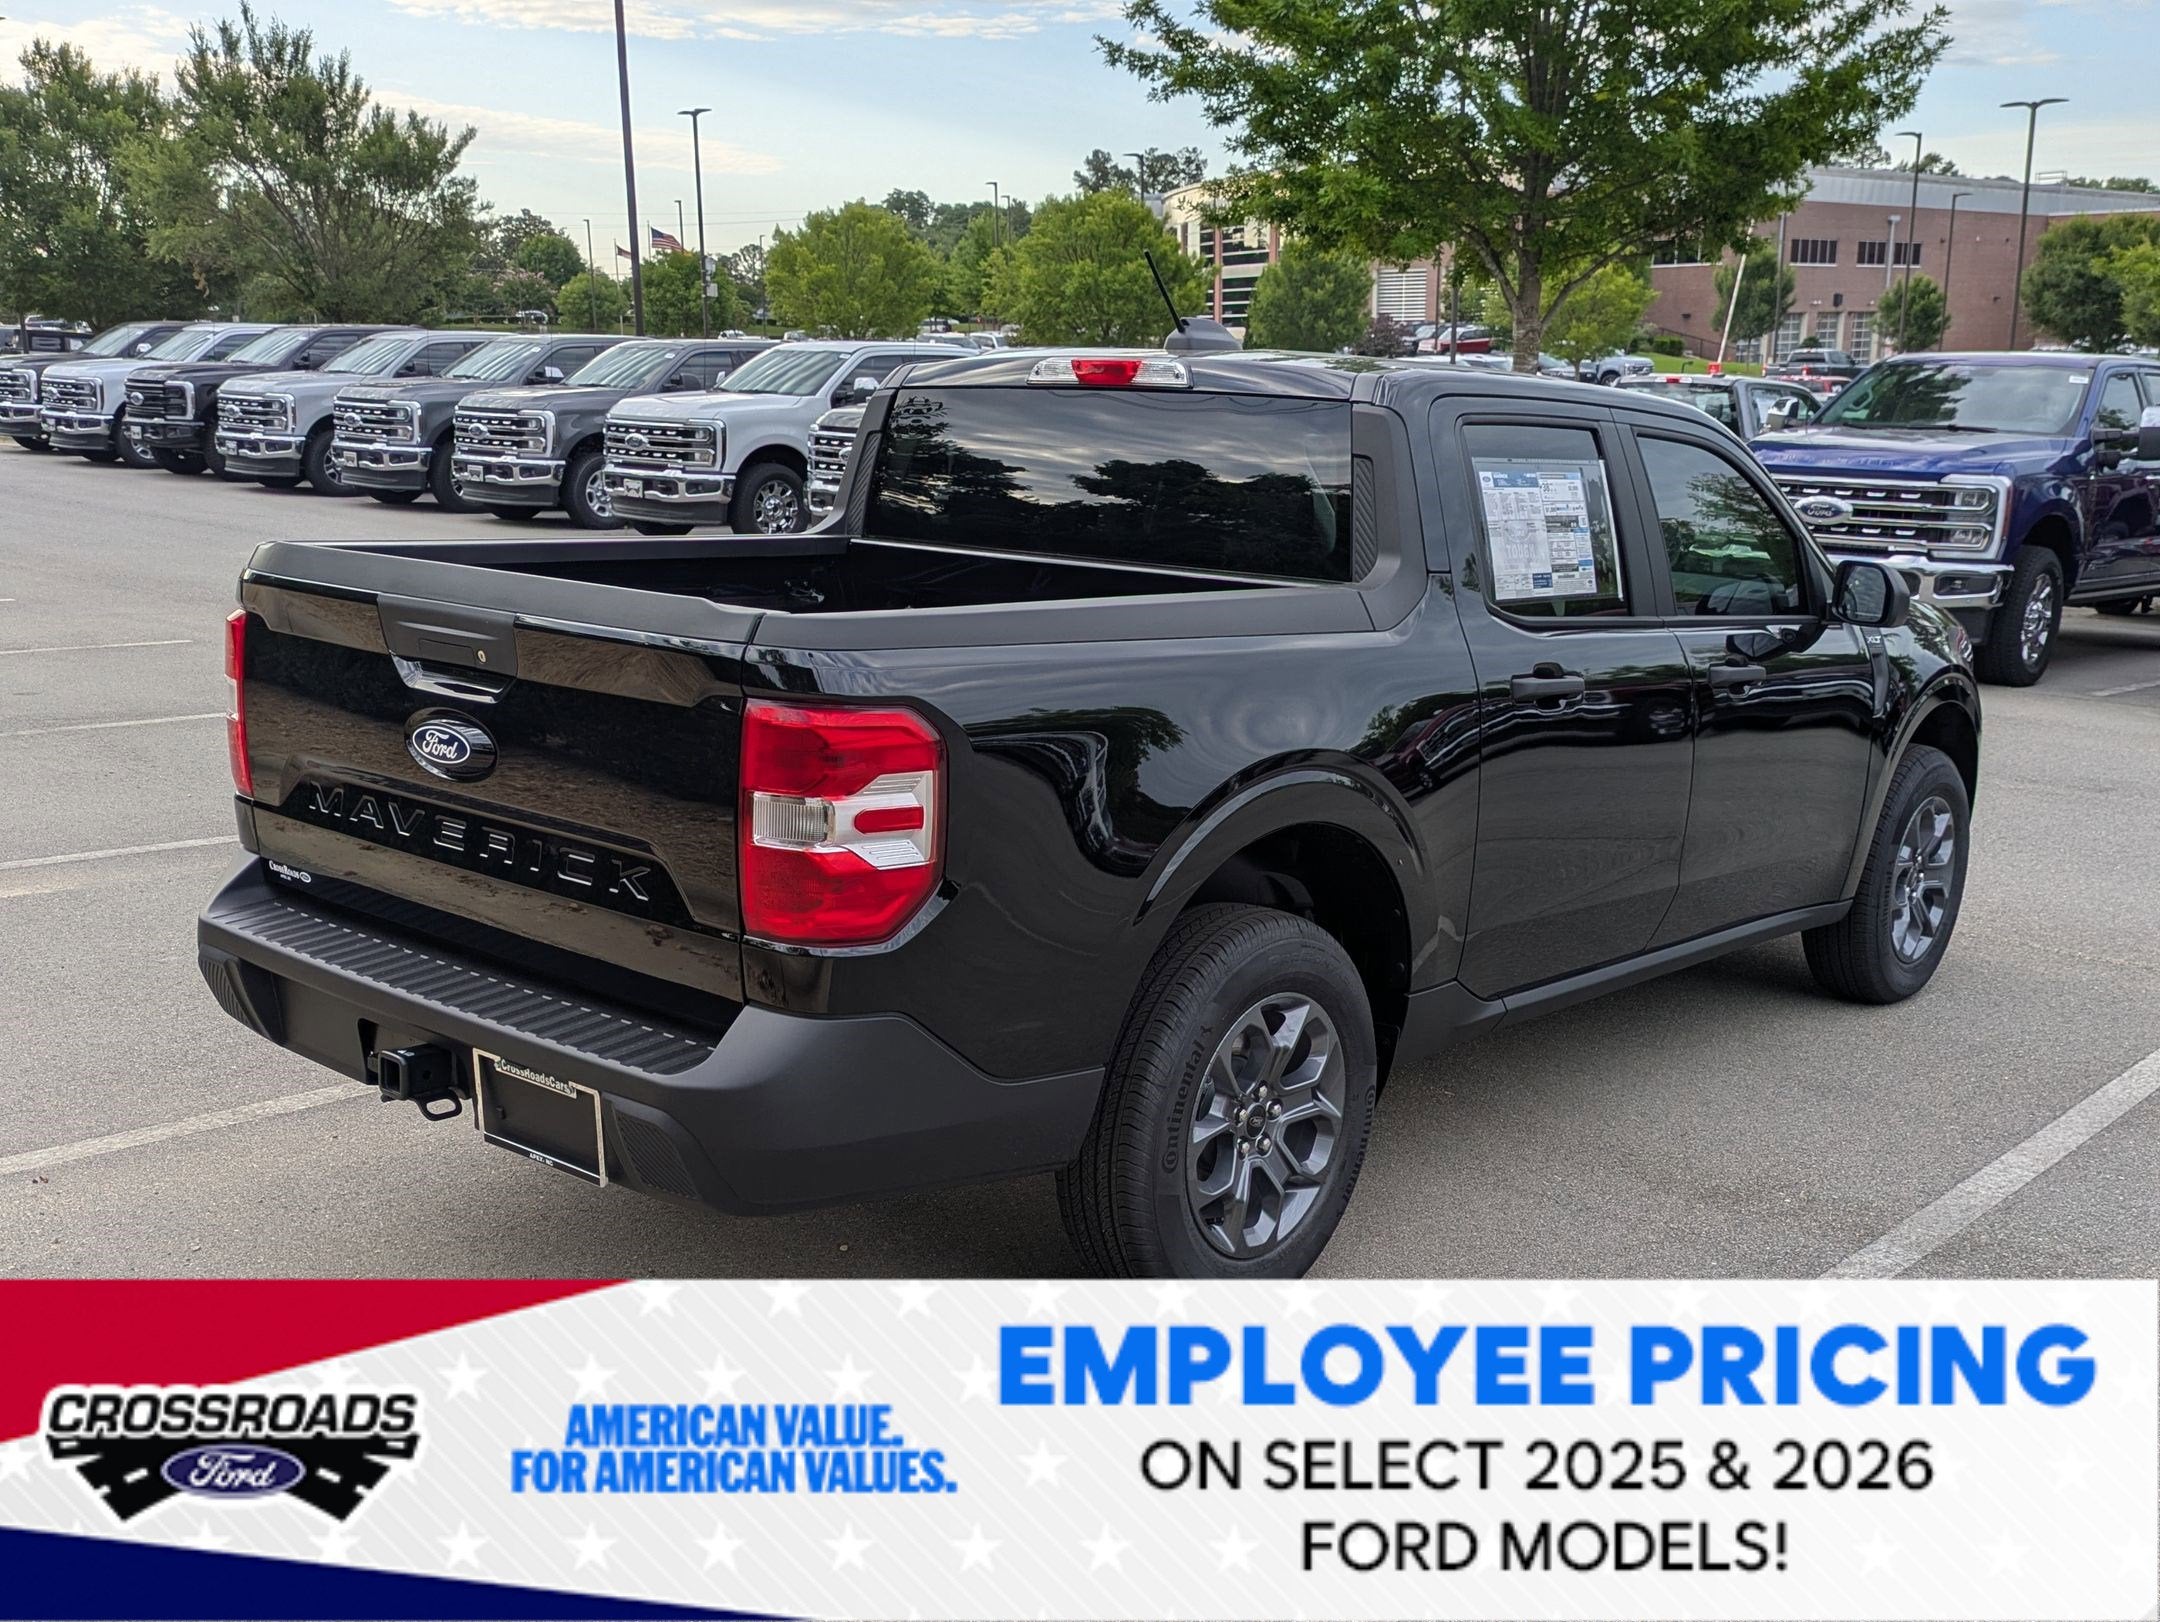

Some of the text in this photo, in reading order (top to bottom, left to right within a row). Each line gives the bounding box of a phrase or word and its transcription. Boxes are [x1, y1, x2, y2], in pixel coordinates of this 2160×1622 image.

[422, 729, 459, 759] Ford
[308, 780, 650, 901] MAVERICK
[1163, 1039, 1205, 1173] Continental
